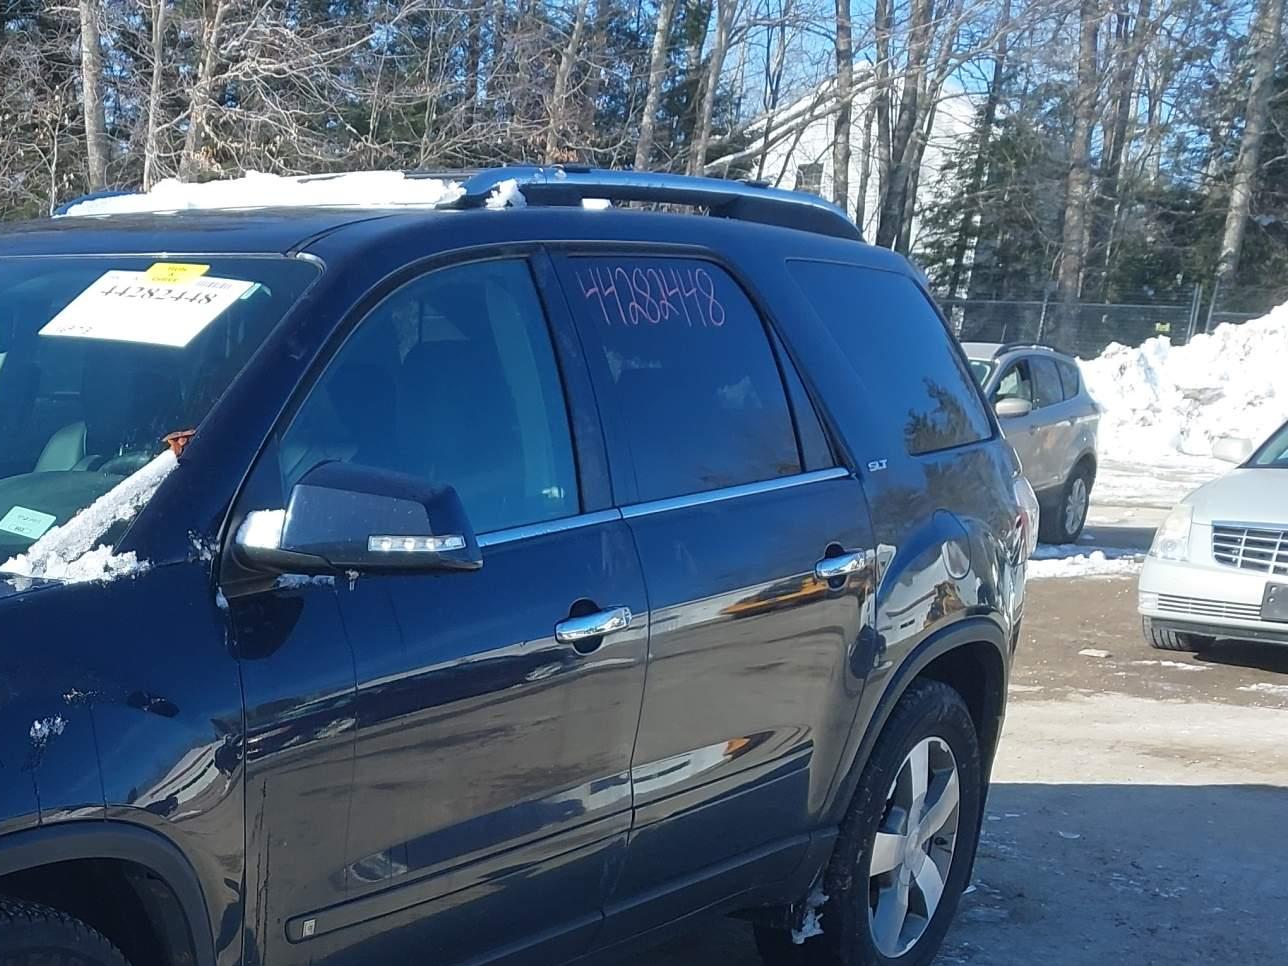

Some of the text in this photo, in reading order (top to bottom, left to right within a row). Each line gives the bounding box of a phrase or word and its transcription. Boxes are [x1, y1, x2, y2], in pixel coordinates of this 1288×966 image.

[100, 285, 218, 305] 44282448
[576, 266, 725, 327] 44282448
[868, 459, 888, 472] SLT
